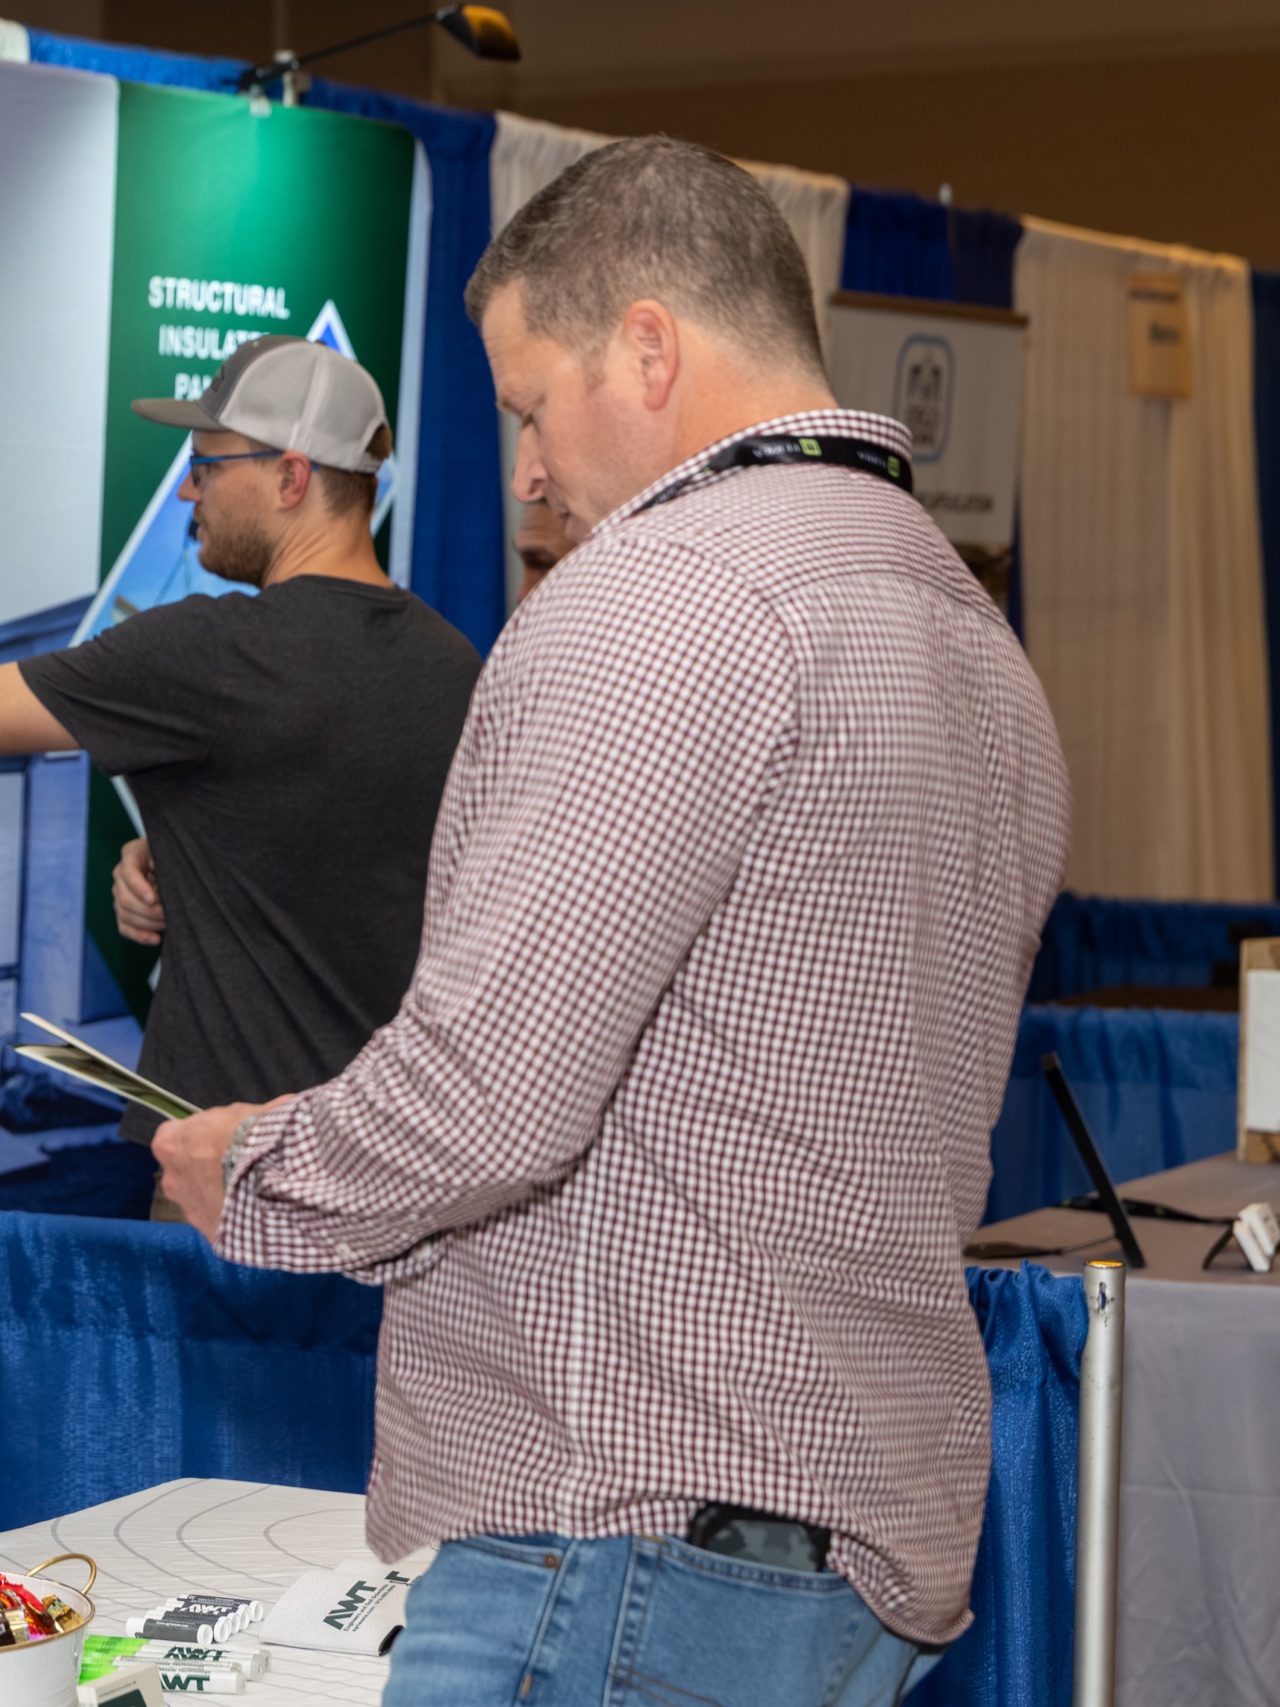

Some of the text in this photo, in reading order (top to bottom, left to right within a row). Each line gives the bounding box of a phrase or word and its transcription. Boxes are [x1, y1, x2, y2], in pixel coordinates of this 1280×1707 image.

[148, 275, 290, 319] STRUCTURAL
[323, 1581, 376, 1630] AWT
[161, 1673, 210, 1691] WT
